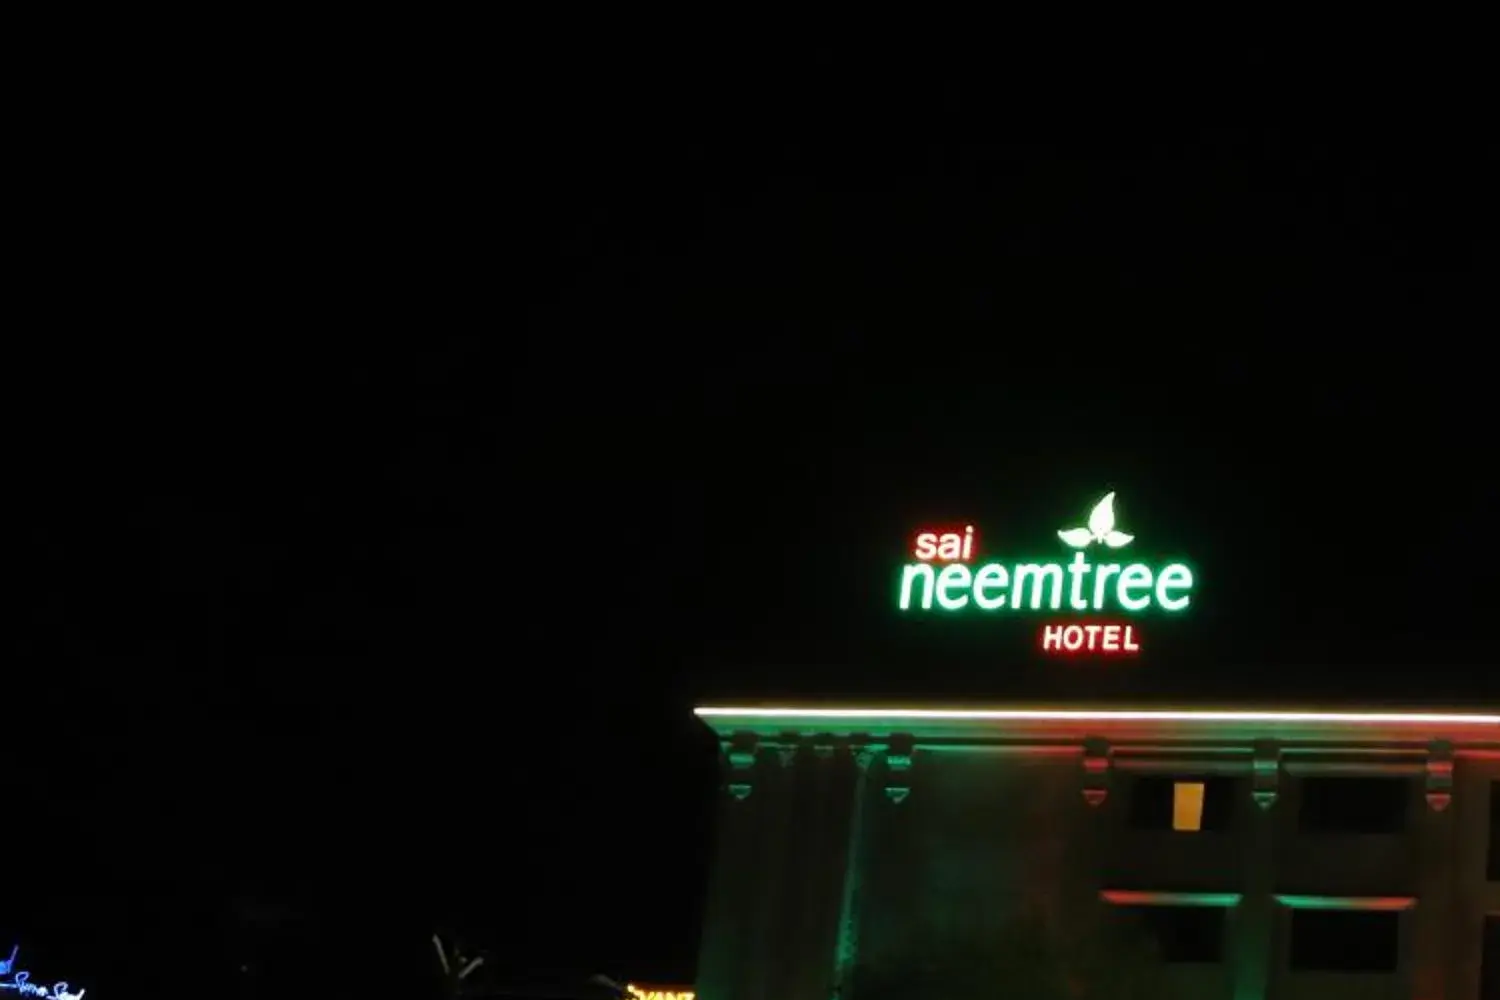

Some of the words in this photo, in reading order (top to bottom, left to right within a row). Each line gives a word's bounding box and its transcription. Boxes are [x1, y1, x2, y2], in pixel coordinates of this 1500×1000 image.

[915, 526, 975, 560] sai
[899, 552, 1194, 611] neemtree
[1043, 625, 1140, 651] HOTEL
